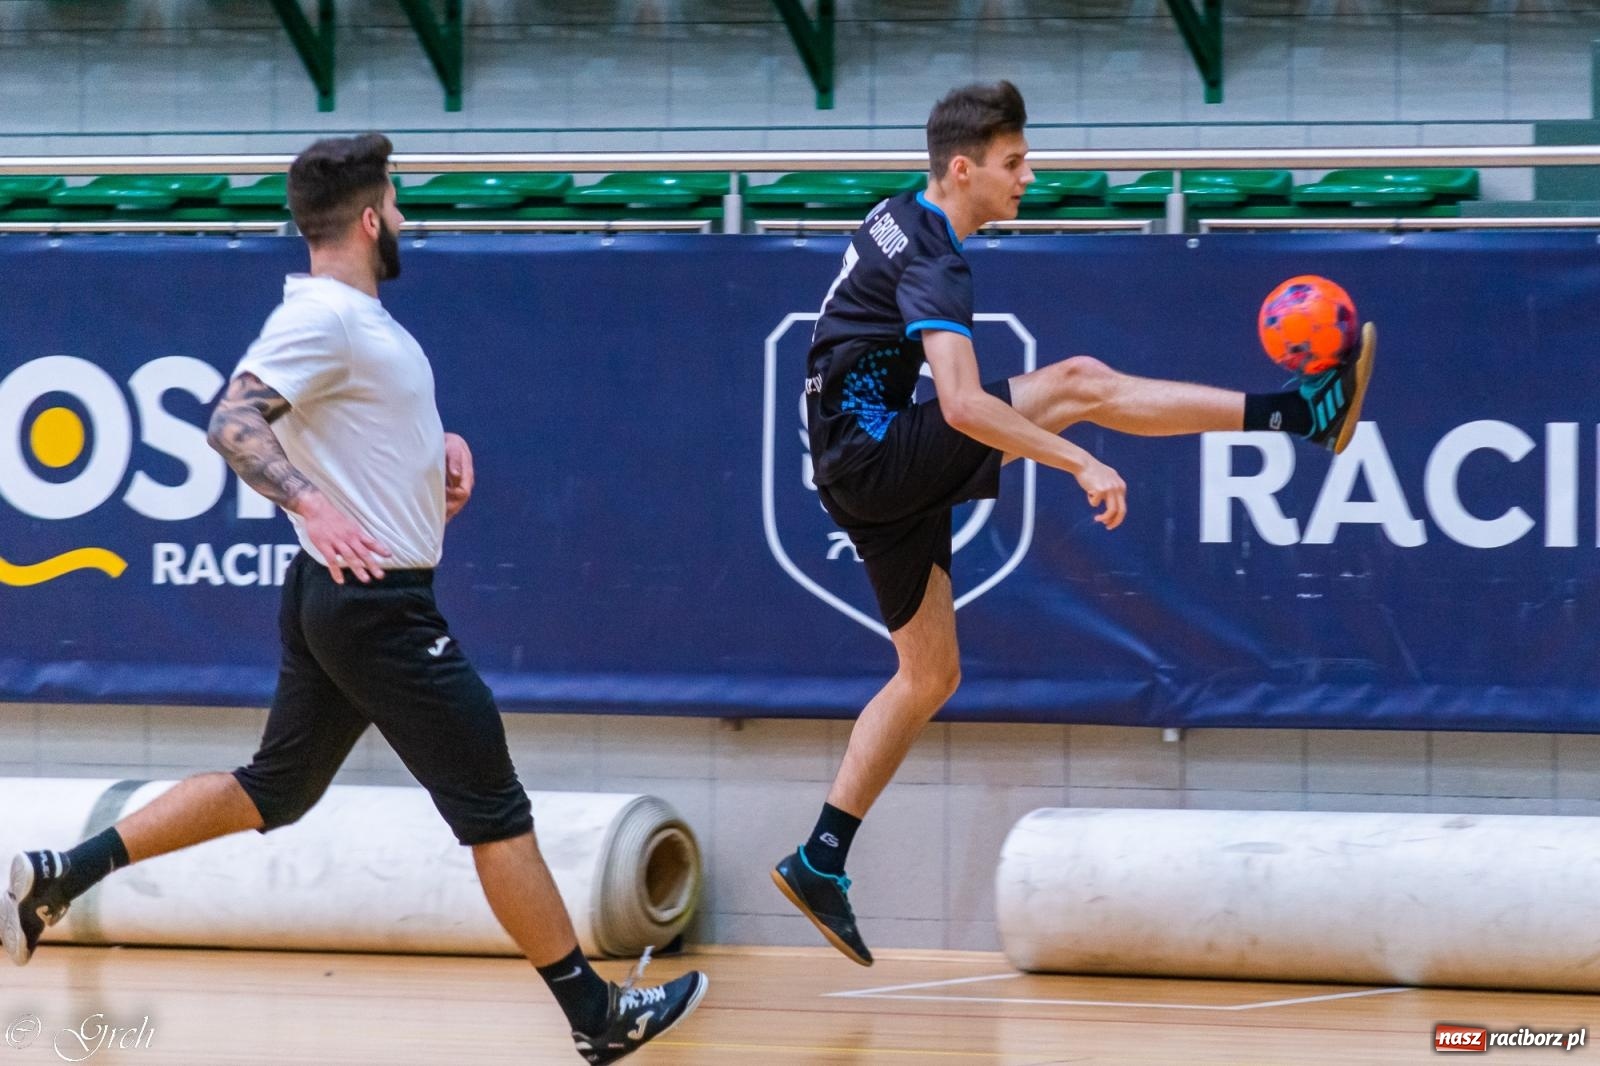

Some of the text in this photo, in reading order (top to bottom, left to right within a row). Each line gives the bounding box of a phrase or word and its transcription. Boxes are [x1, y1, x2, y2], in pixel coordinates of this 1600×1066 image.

[865, 198, 909, 259] -GROUP
[0, 355, 276, 520] OS
[1199, 419, 1600, 549] RACI
